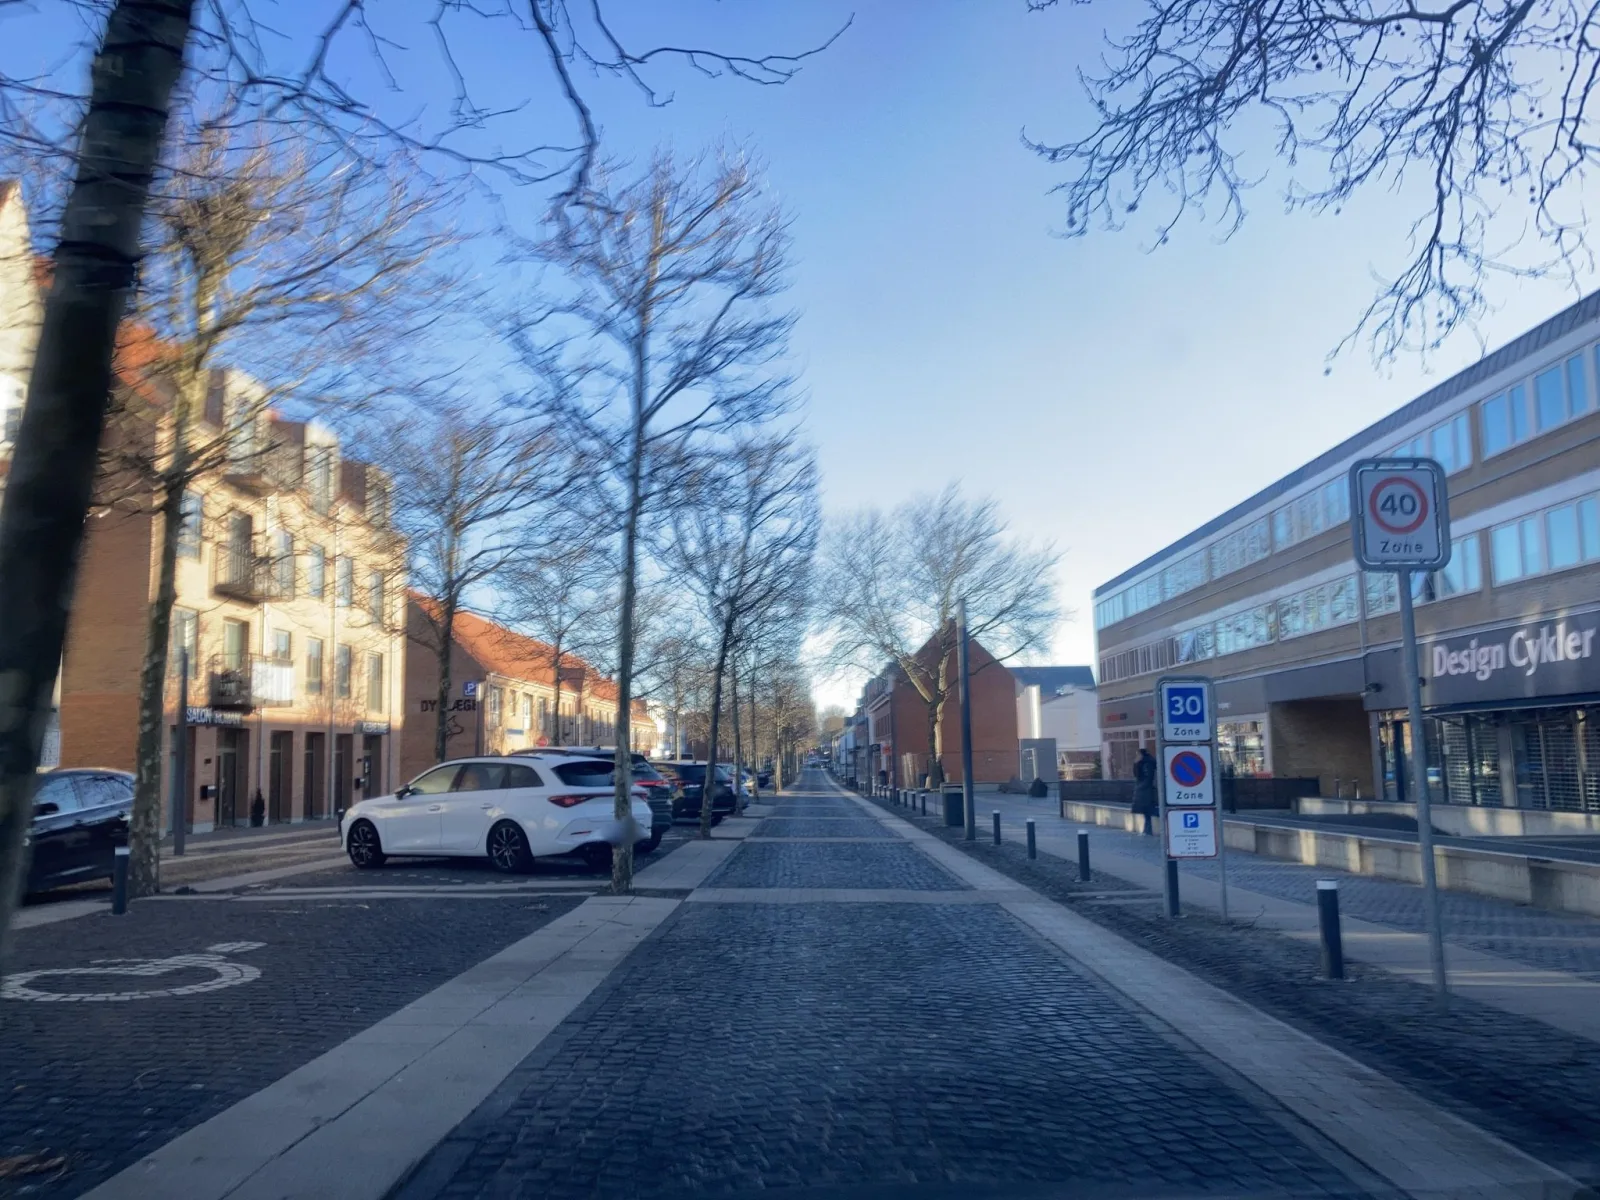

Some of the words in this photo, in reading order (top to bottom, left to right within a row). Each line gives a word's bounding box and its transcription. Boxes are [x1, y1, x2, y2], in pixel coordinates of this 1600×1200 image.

[1380, 493, 1417, 516] 40
[1381, 542, 1423, 553] Zone
[1433, 638, 1505, 681] Design
[1508, 622, 1595, 675] Cykler
[1170, 695, 1201, 716] 30
[1173, 727, 1201, 736] Zone
[1176, 791, 1204, 800] Zone
[1187, 814, 1196, 827] P
